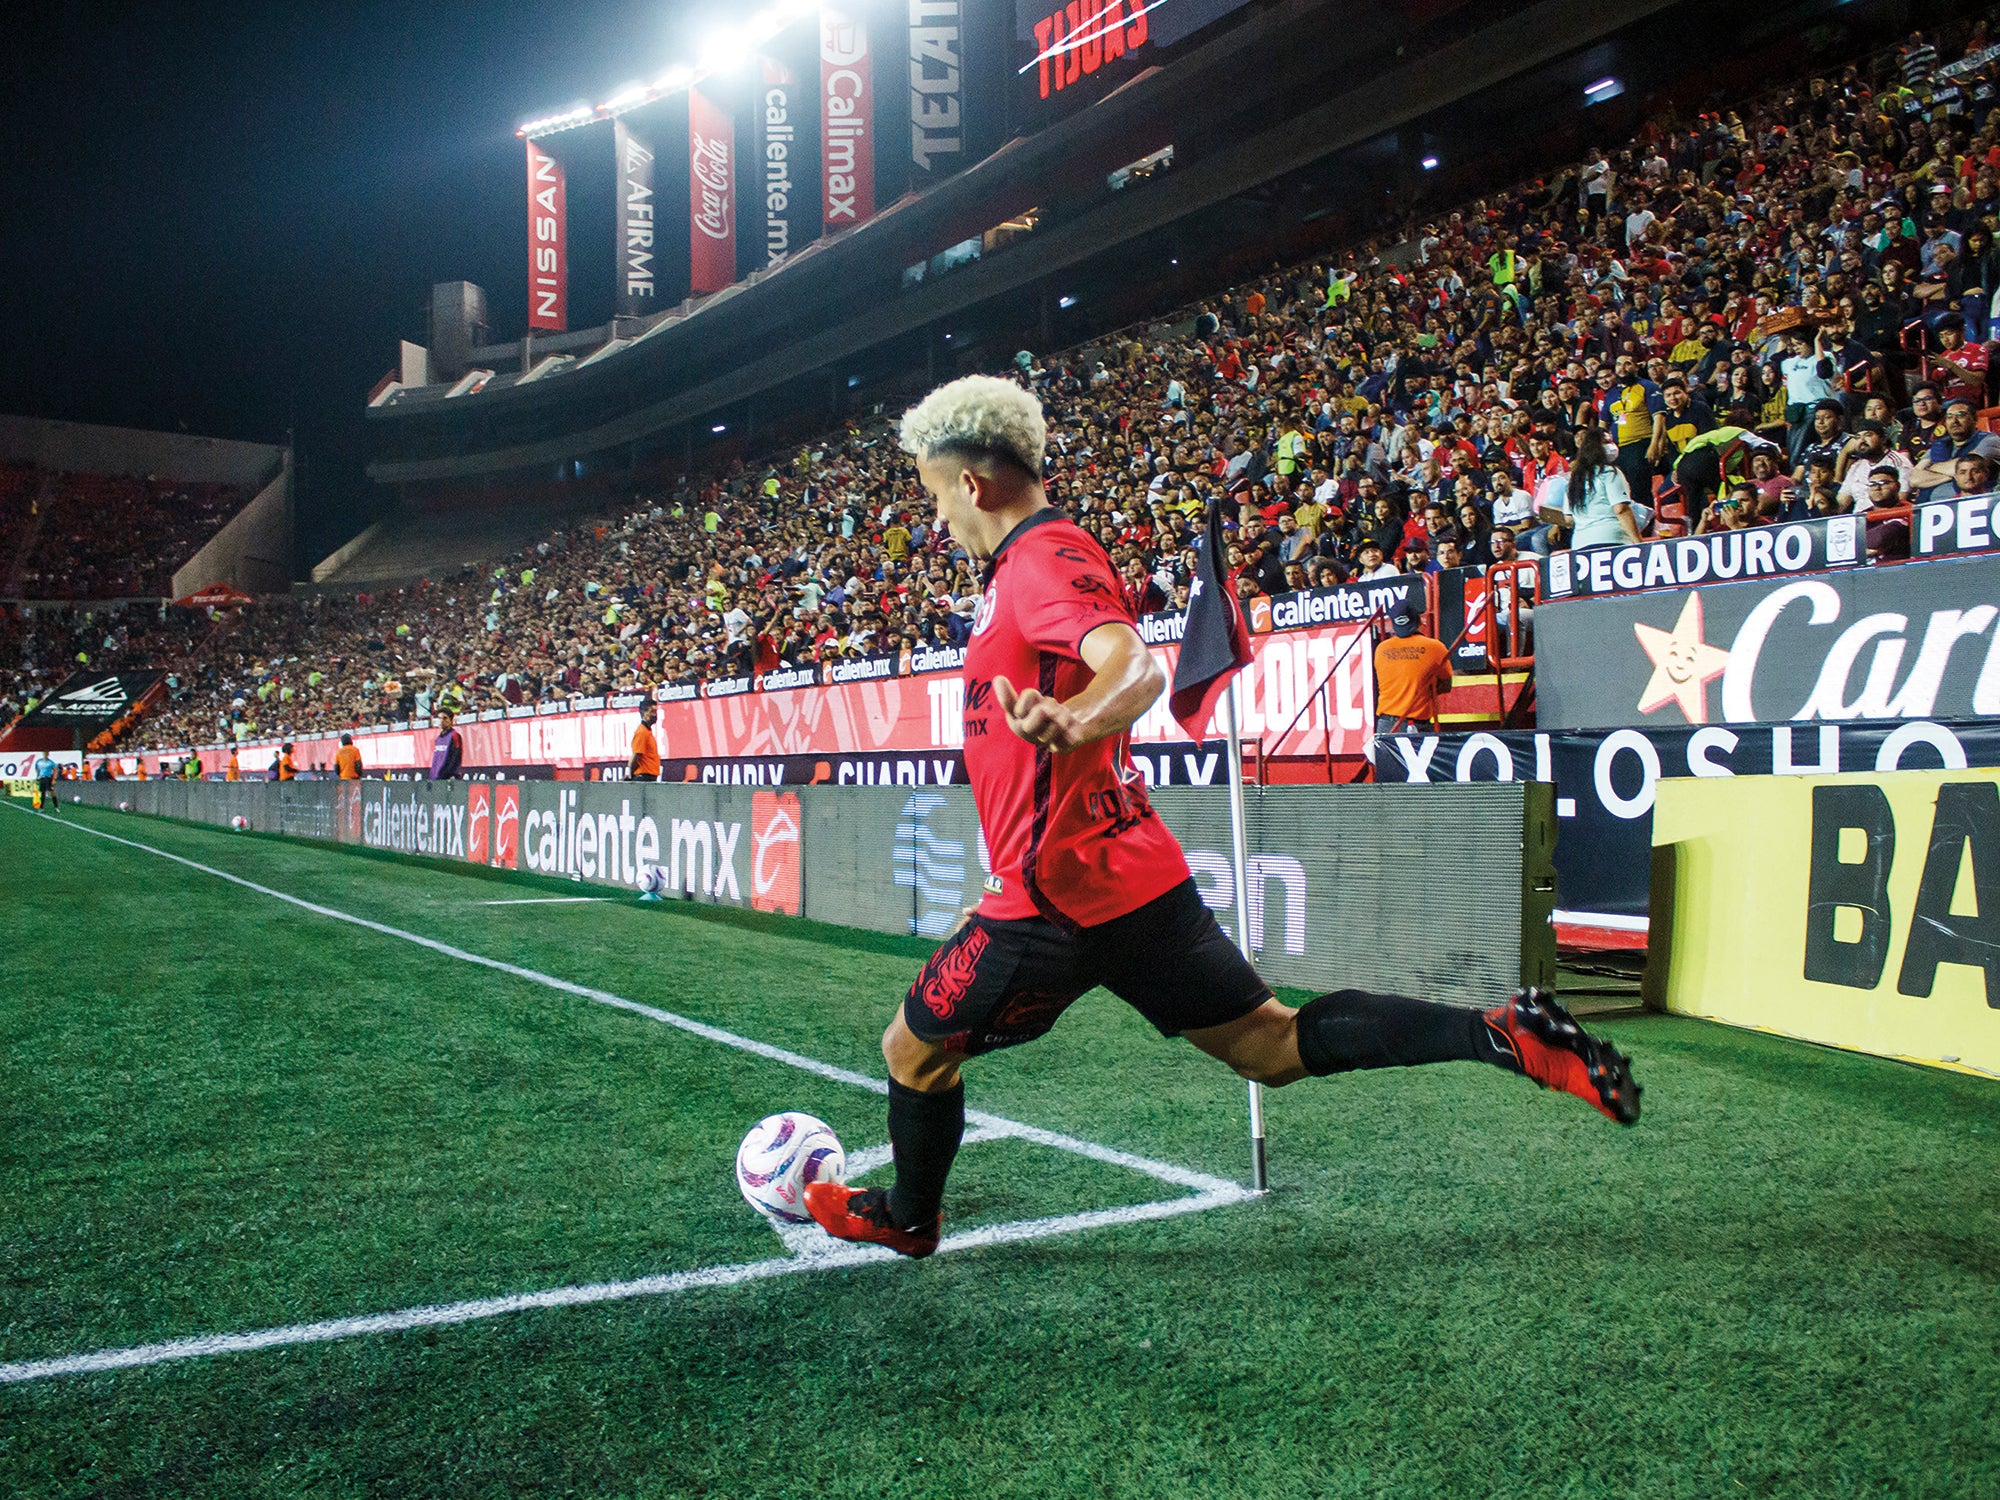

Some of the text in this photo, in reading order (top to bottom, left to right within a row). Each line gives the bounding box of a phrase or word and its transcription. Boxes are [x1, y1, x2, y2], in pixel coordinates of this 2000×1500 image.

[765, 88, 794, 268] caliente.mx
[827, 69, 864, 218] Calimax
[536, 155, 558, 318] NISSAN
[627, 179, 654, 297] AFIRME
[1919, 498, 2000, 554] PE
[763, 669, 815, 691] caliente.mx
[832, 658, 891, 682] caliente.mx
[364, 786, 465, 857] caliente.mx
[524, 789, 742, 900] caliente.mx
